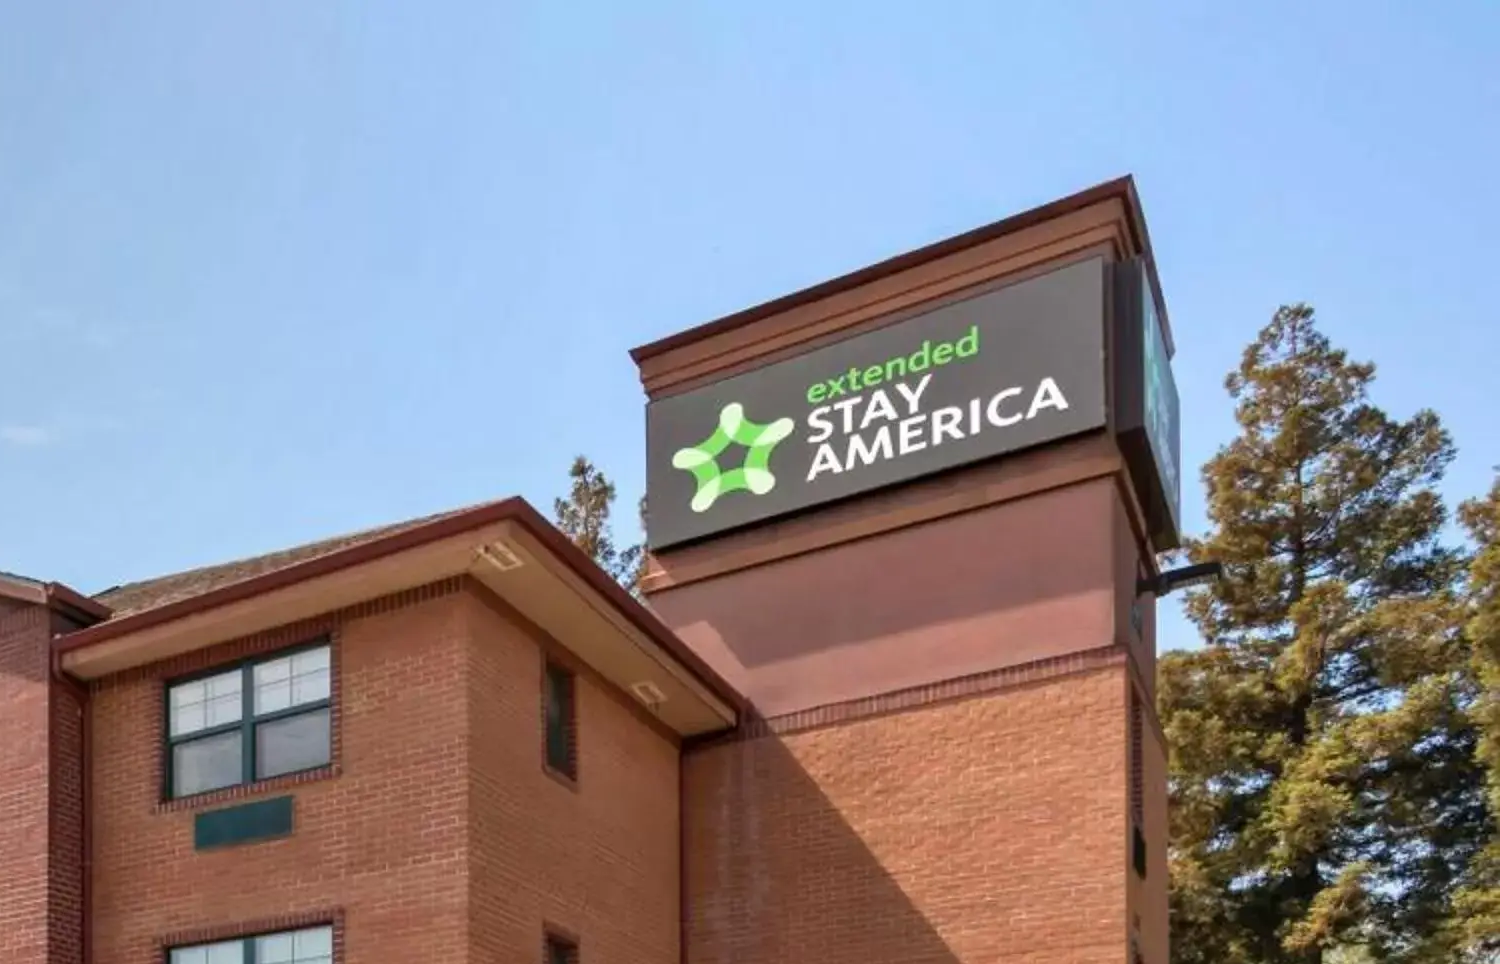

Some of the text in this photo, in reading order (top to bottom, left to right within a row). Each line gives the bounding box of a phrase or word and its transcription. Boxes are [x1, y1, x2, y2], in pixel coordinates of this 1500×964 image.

[807, 325, 980, 404] extended
[805, 376, 1070, 482] AMERICA
[807, 373, 933, 444] STAY
